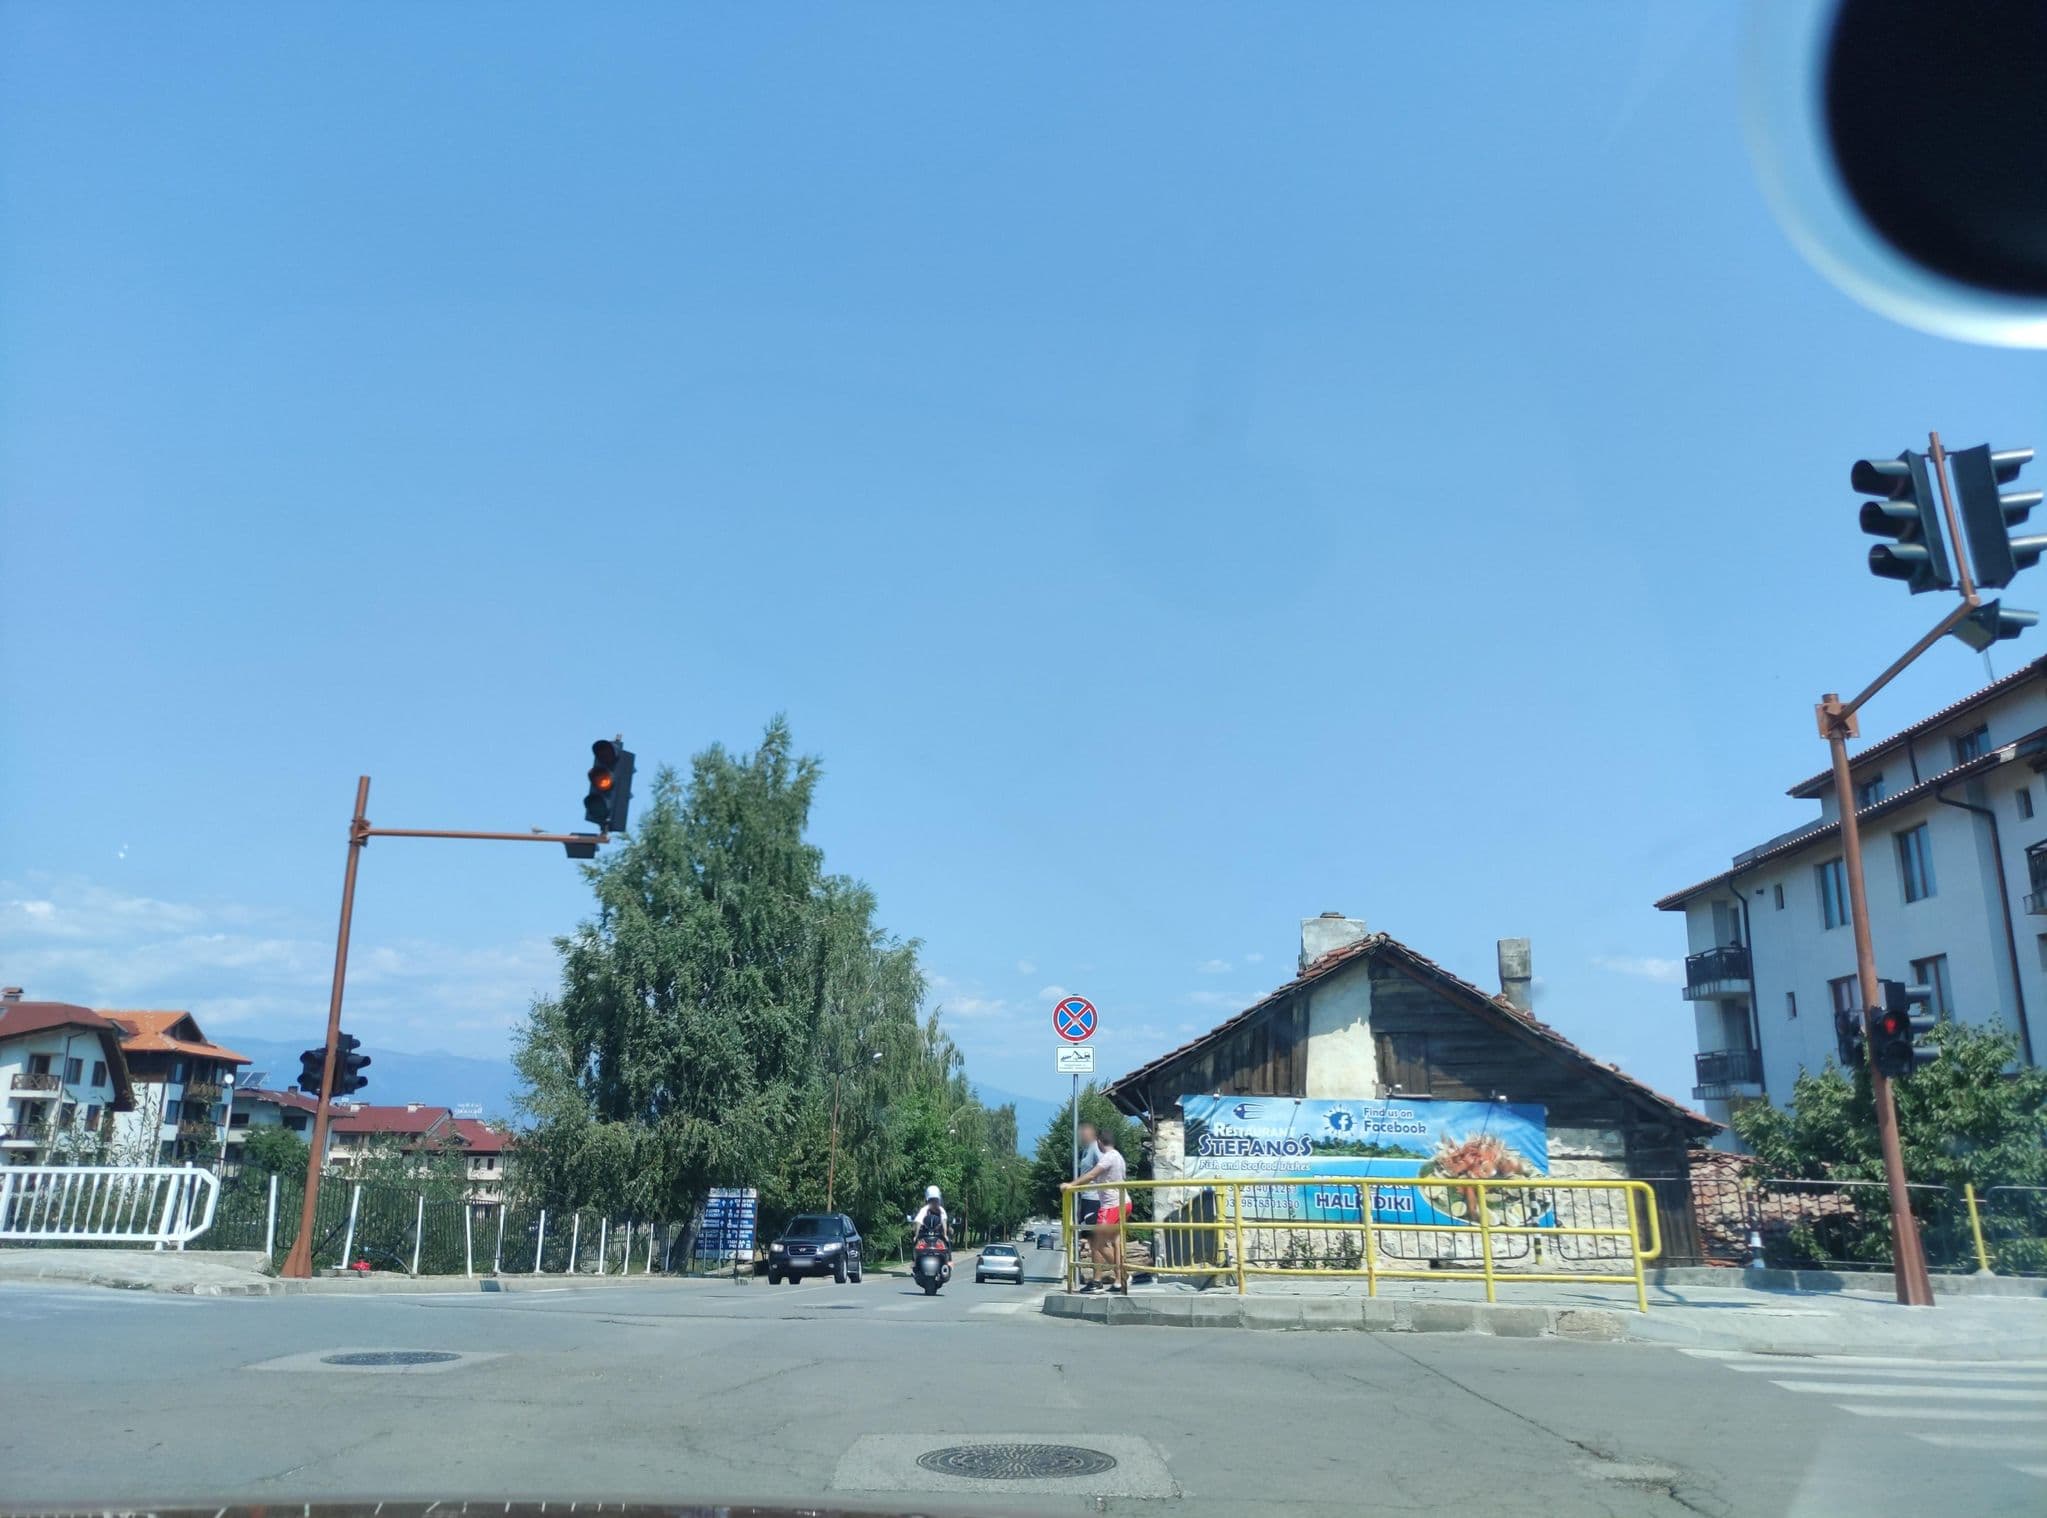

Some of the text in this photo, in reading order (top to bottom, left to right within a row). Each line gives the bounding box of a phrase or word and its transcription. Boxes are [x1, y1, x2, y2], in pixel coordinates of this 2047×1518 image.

[1364, 1107, 1413, 1118] Find us on
[1363, 1120, 1427, 1134] Facebook
[1199, 1134, 1313, 1156] STEFANOS
[1200, 1160, 1311, 1173] Fish and Seafood Dishes
